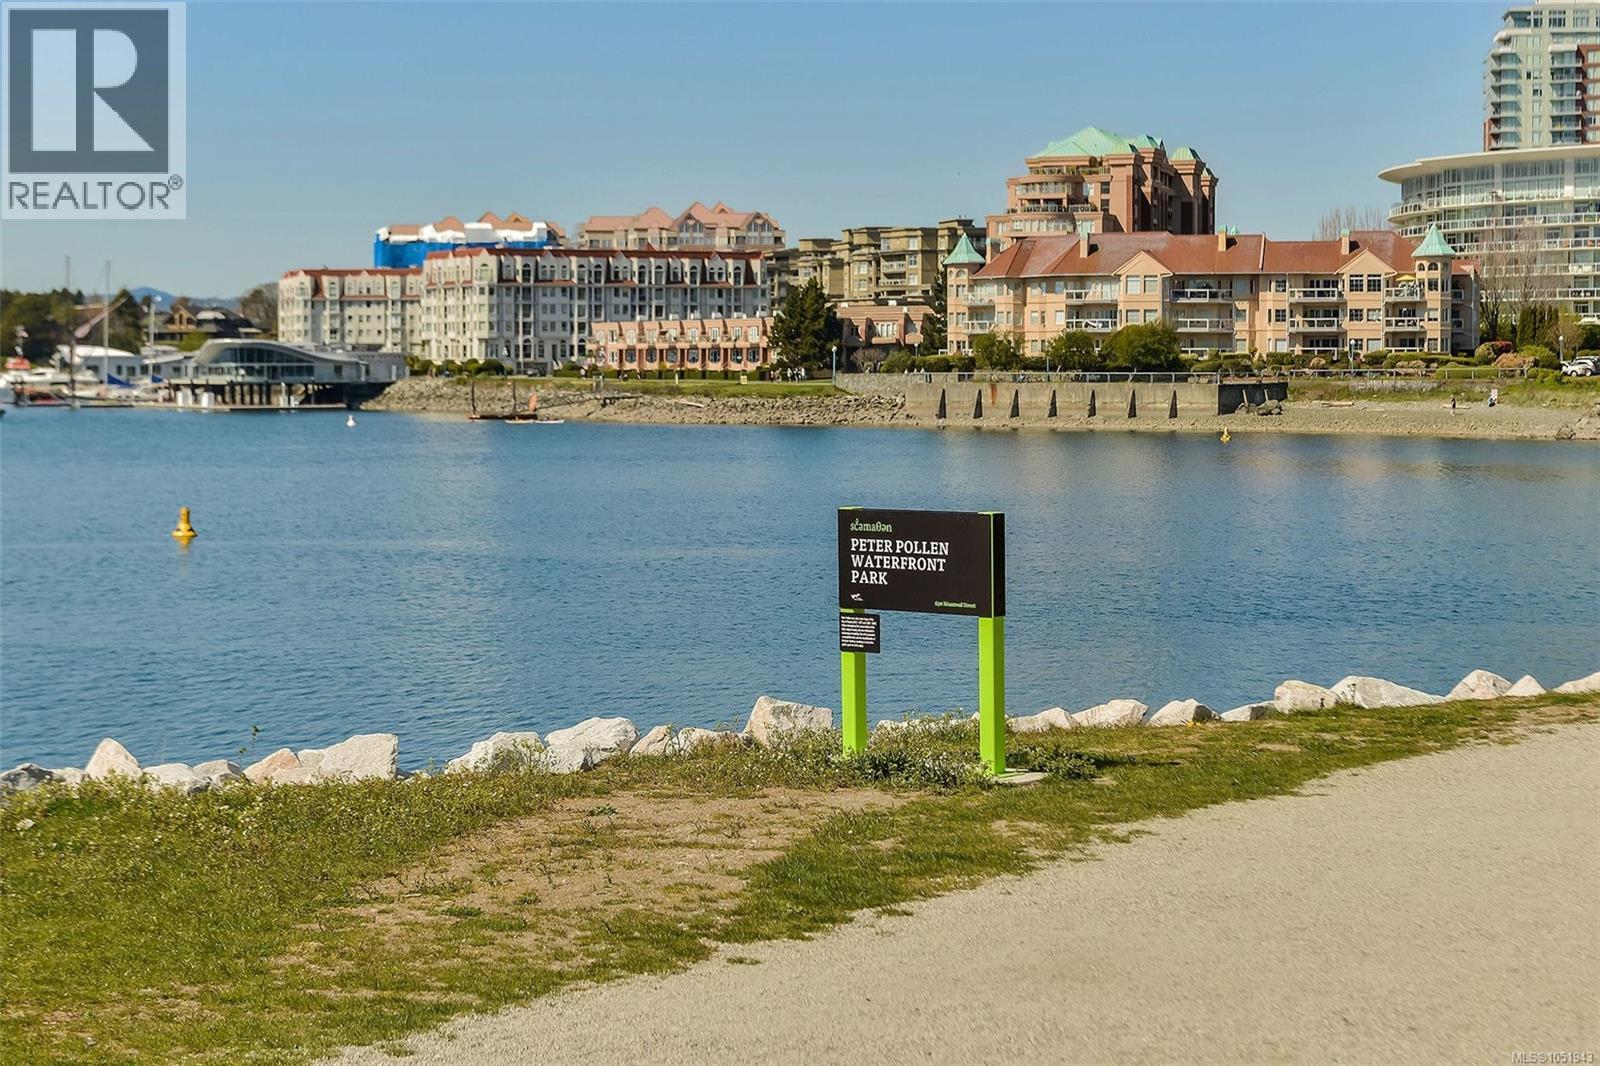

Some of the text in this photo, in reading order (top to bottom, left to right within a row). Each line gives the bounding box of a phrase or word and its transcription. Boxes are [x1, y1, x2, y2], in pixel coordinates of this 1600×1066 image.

[851, 538, 949, 555] PETER POLLEN
[851, 554, 946, 571] WATERFRONT
[851, 570, 888, 585] PARK
